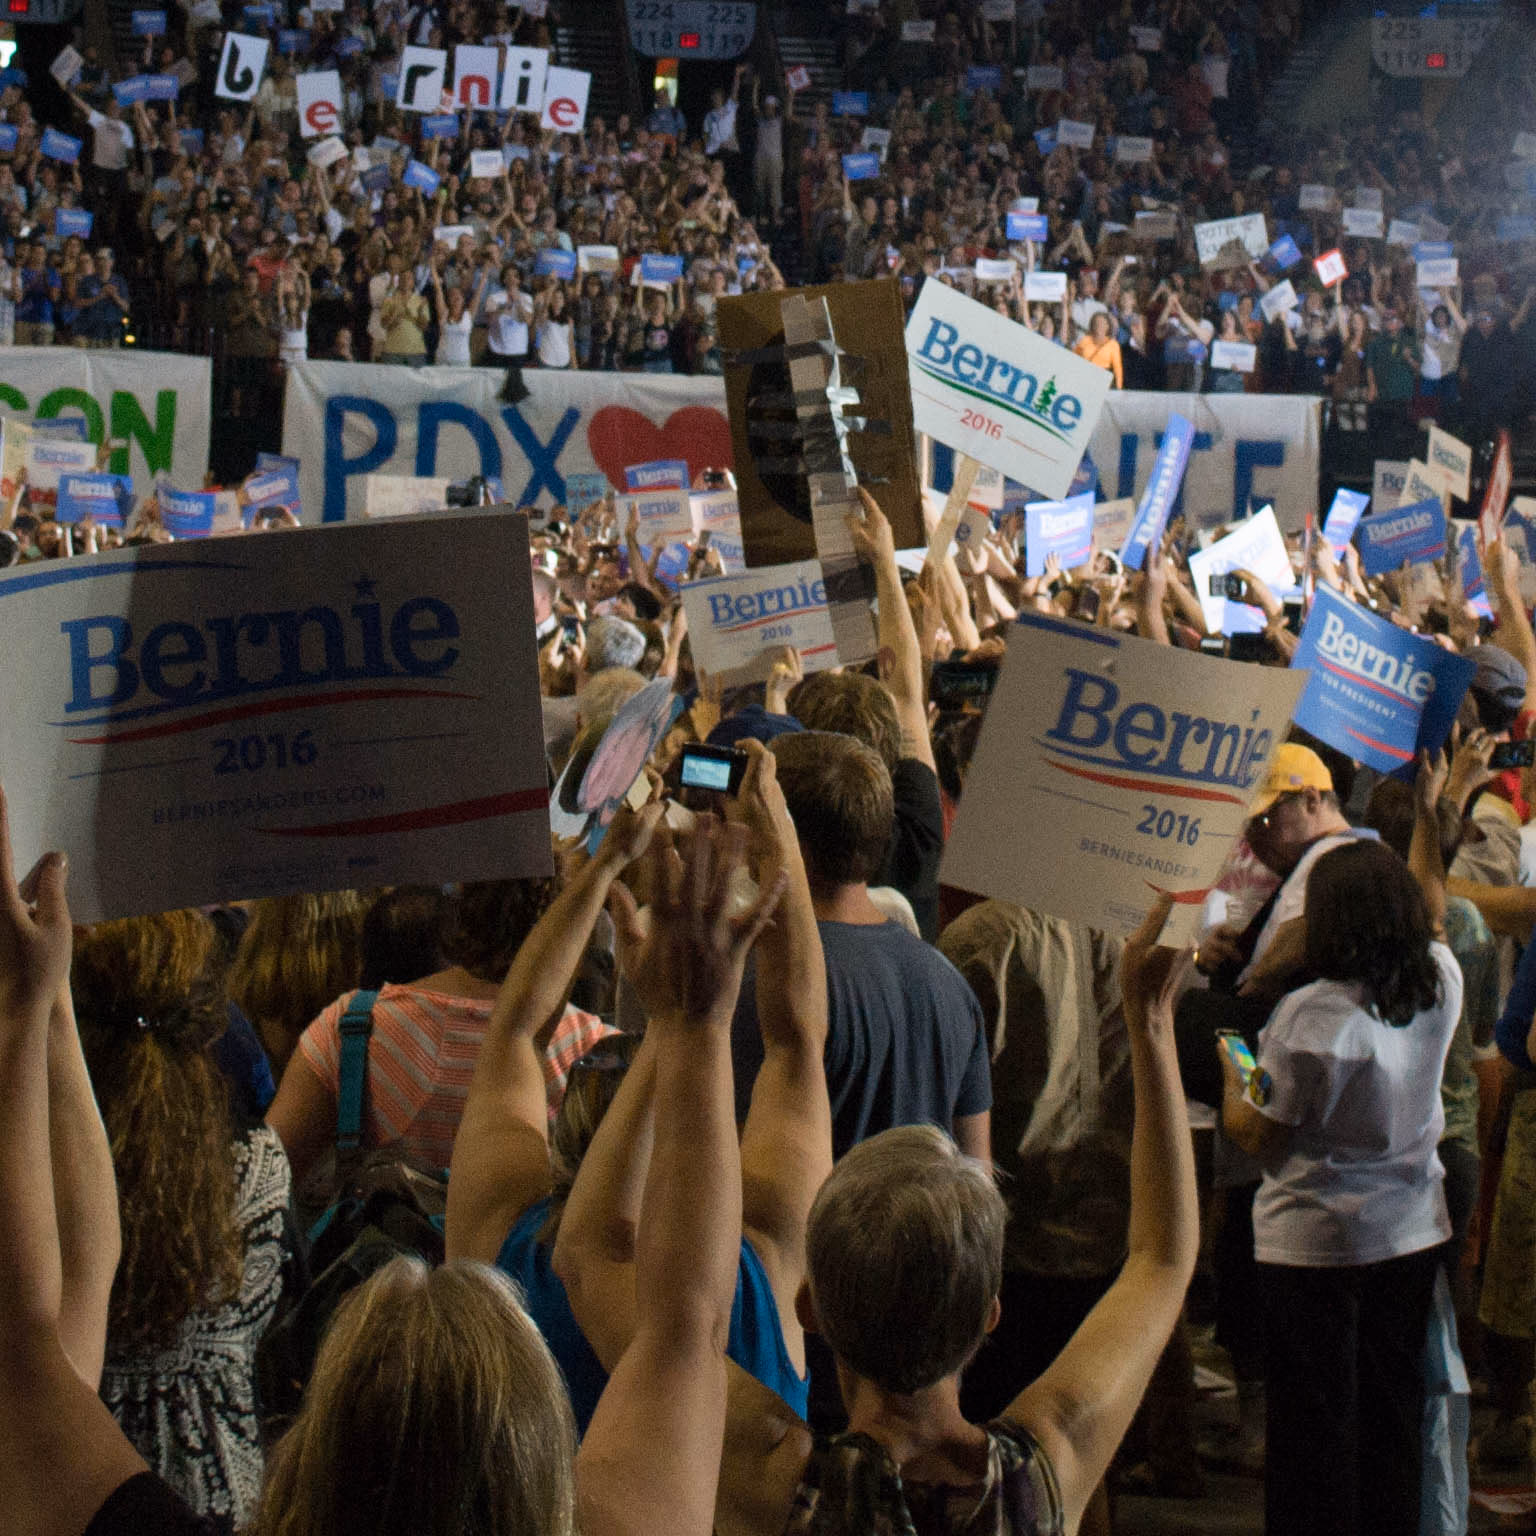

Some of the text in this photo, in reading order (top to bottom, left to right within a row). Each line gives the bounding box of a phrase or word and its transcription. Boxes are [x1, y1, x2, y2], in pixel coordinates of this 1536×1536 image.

[959, 407, 1004, 441] 2016
[323, 394, 583, 524] PDX
[1367, 511, 1433, 544] Bernie
[706, 575, 827, 625] Bernie
[60, 576, 461, 715] Bernie
[761, 623, 794, 641] 2016
[1316, 609, 1437, 704] Bernie
[210, 728, 319, 776] 2016
[1045, 666, 1274, 789] Bernie
[1135, 803, 1202, 847] 2016
